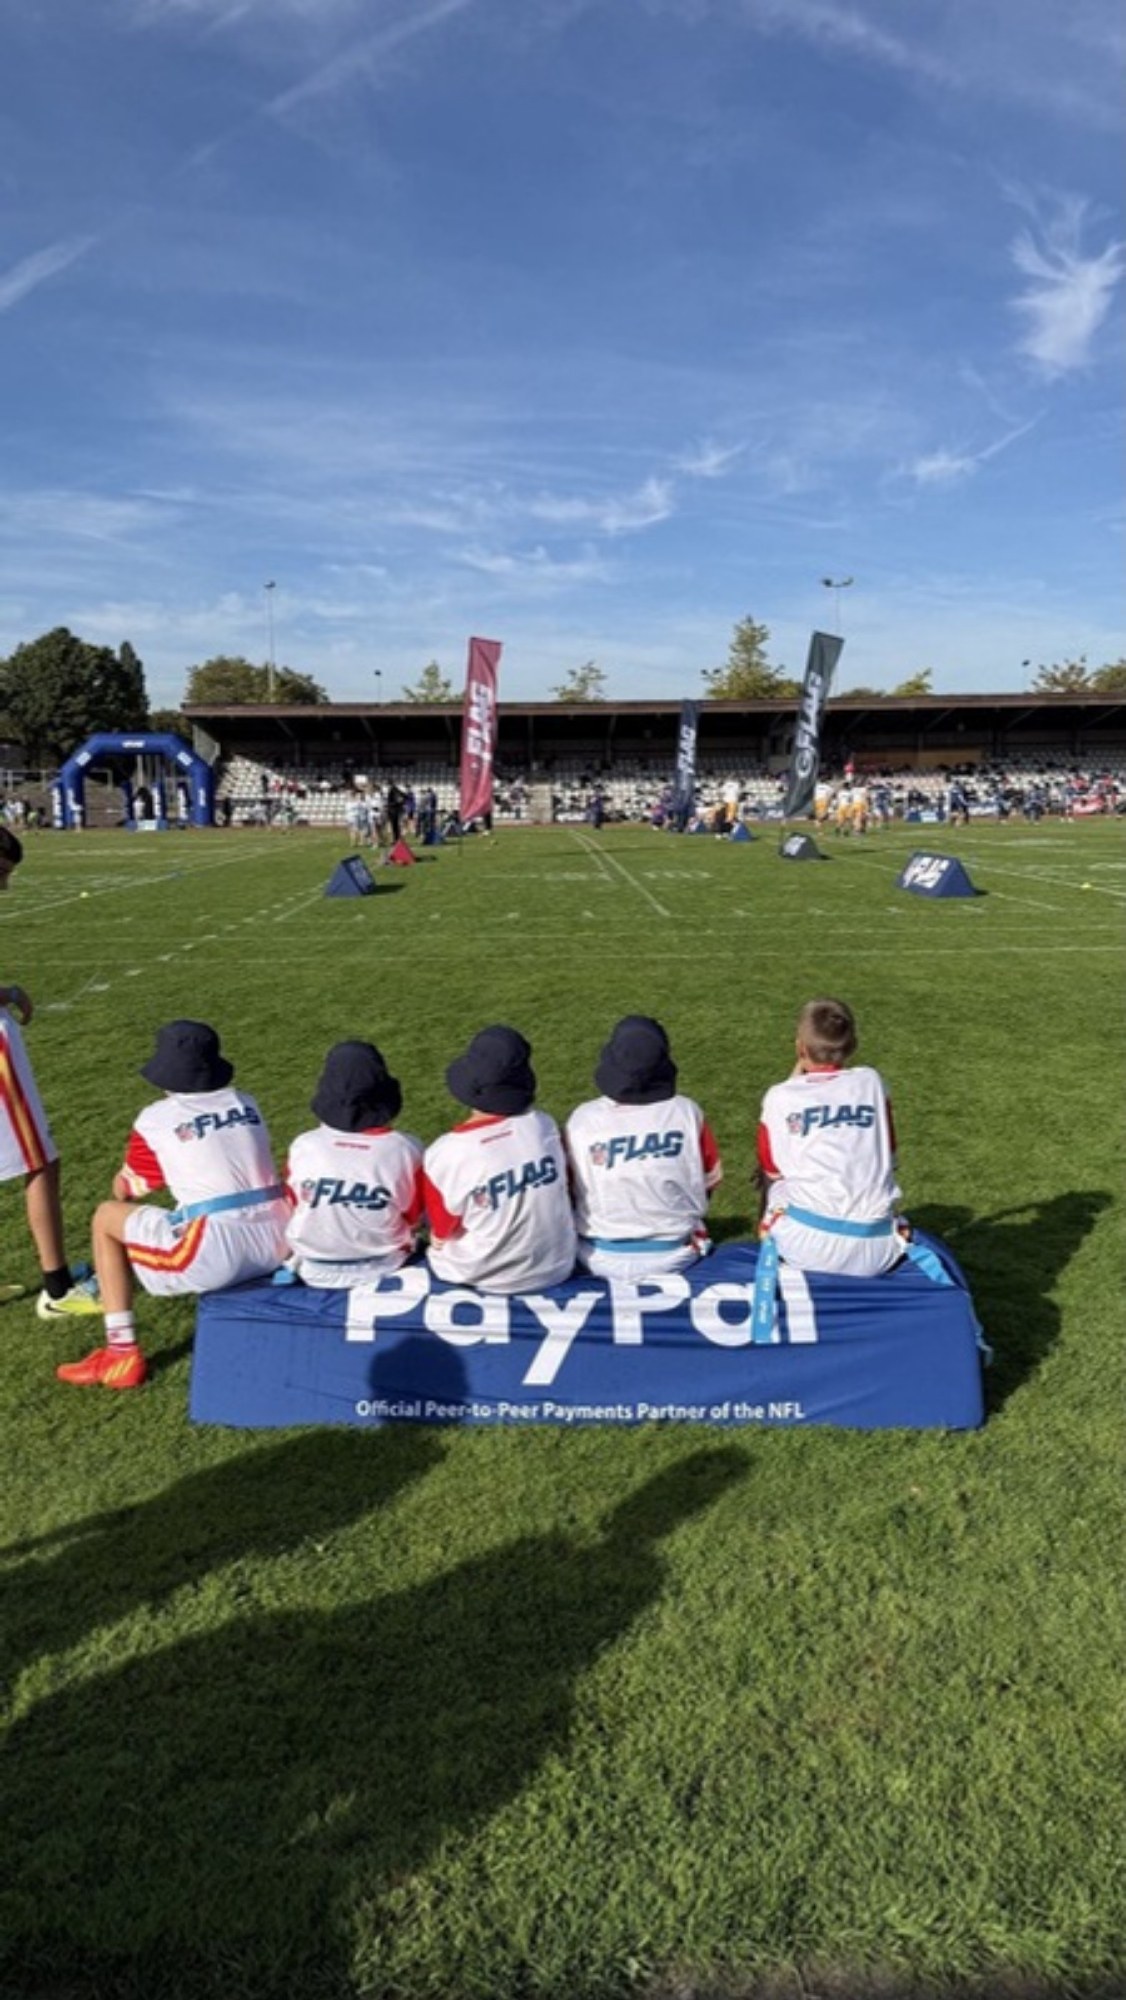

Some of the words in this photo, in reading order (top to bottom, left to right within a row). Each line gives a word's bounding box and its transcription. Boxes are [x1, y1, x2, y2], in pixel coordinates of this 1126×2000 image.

[467, 681, 495, 762] FLAG
[796, 670, 823, 755] FLAG
[678, 724, 697, 776] FLAG
[193, 1106, 261, 1140] FLAG
[802, 1104, 876, 1137] FLAG
[606, 1130, 684, 1170] FLAG
[310, 1178, 392, 1211] FLAG
[488, 1155, 559, 1211] FLAG
[345, 1266, 818, 1386] PayPal
[355, 1400, 421, 1417] Official
[424, 1400, 538, 1418] Peer-to-Peer
[543, 1401, 632, 1421] Payments
[637, 1402, 706, 1419] Partner
[709, 1401, 731, 1419] of
[733, 1402, 764, 1419] the
[767, 1402, 806, 1419] NFL
